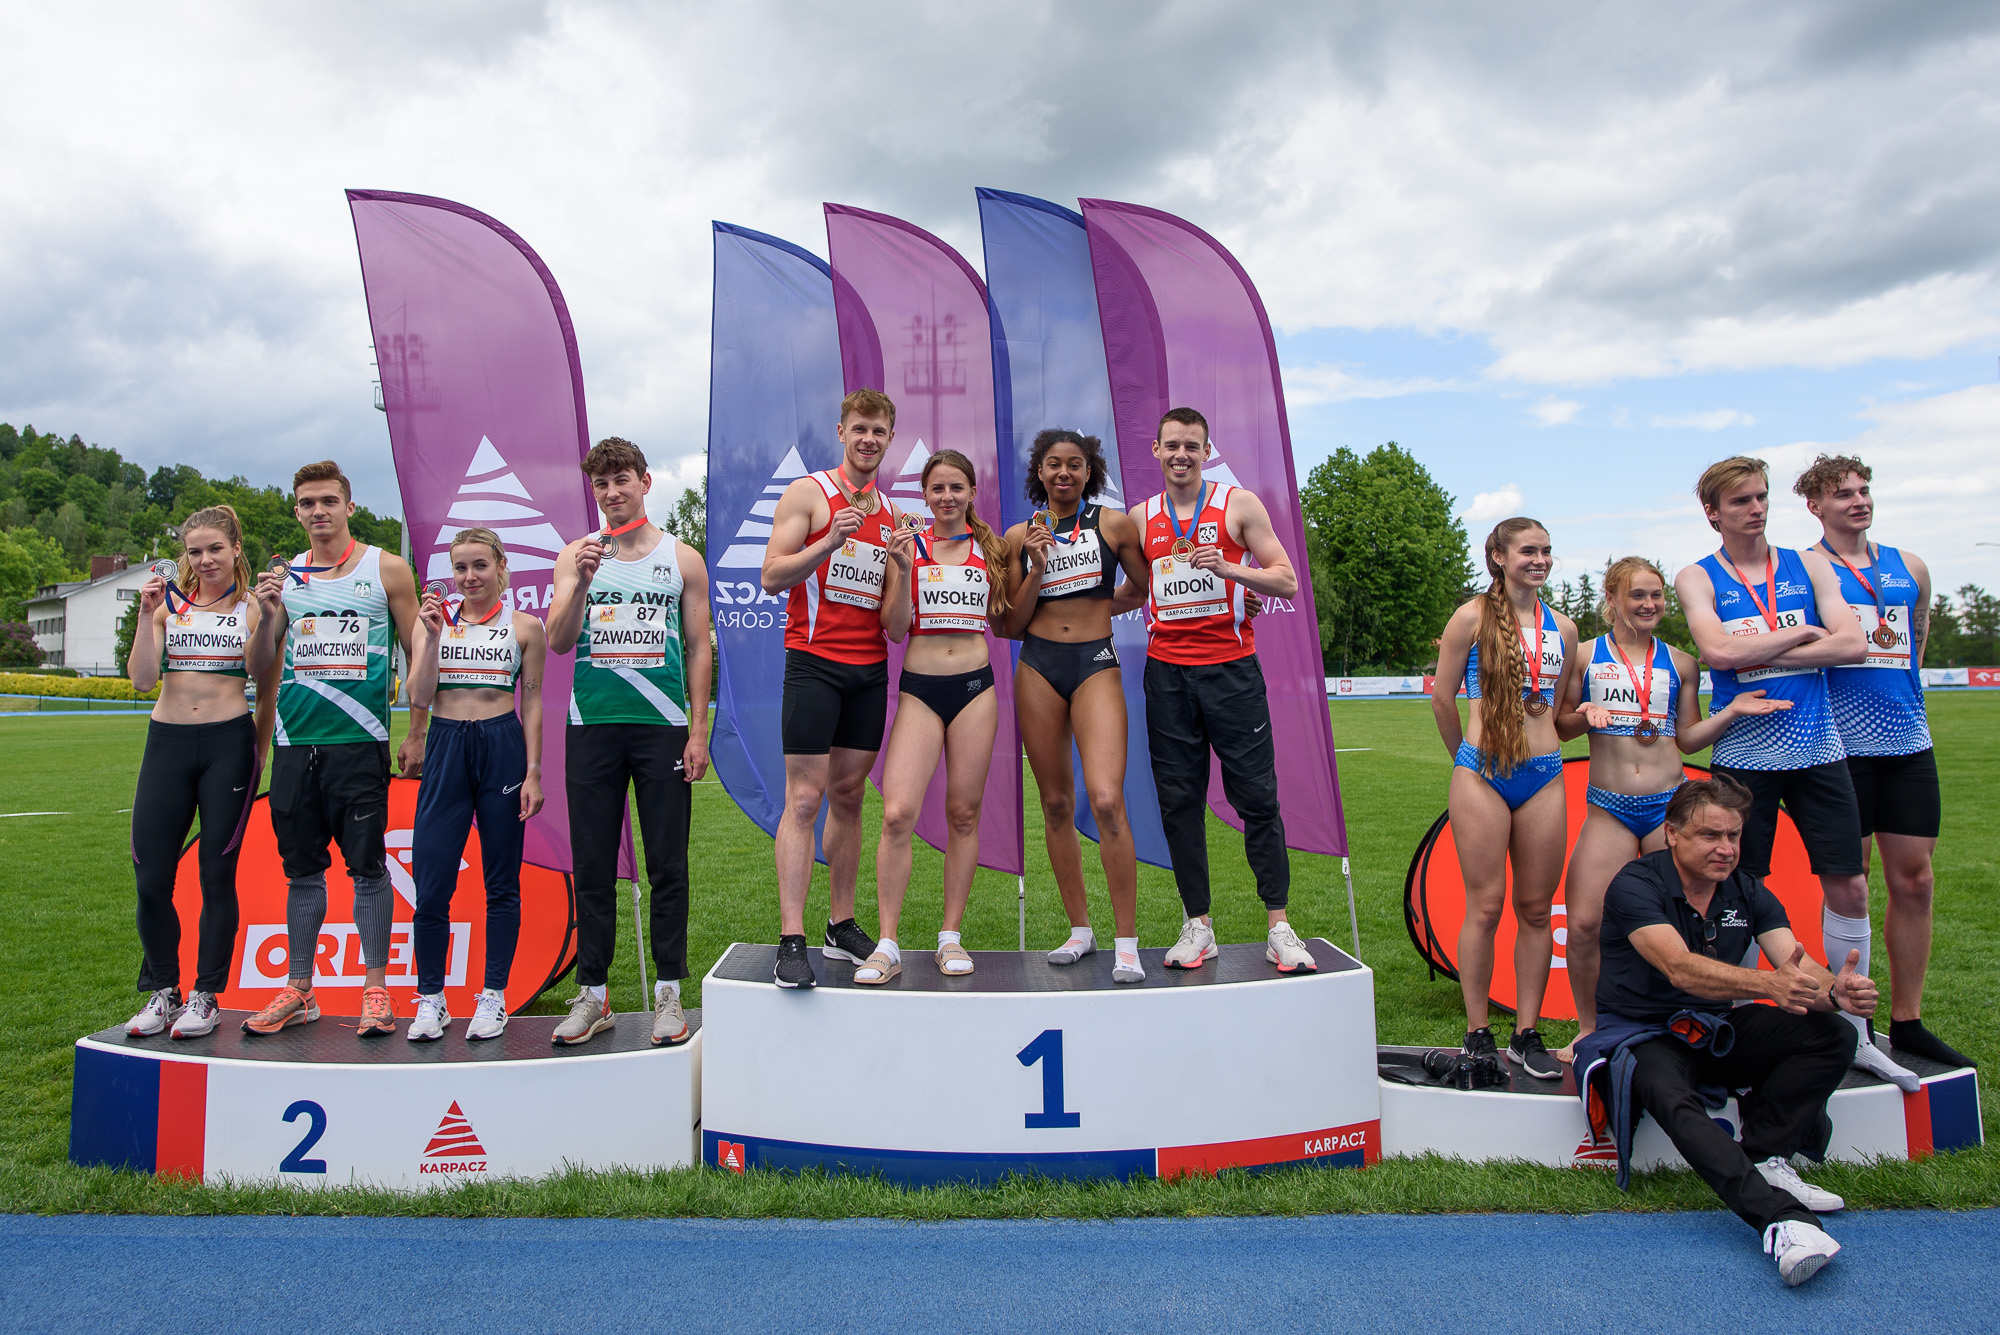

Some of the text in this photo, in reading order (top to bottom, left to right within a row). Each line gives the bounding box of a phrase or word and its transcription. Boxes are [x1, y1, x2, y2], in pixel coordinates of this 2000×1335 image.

[872, 548, 887, 565] 92
[964, 568, 983, 583] 93
[1043, 579, 1088, 595] KARPACZ 2022
[1164, 574, 1214, 597] KIDOŃ
[586, 591, 623, 606] AZS
[833, 592, 863, 603] KARPACZ
[923, 590, 986, 607] WSOŁEK
[636, 607, 657, 621] 87
[1165, 605, 1210, 616] KARPACZ 2022
[216, 615, 238, 627] 78
[338, 619, 360, 633] 76
[1776, 613, 1798, 629] 18
[168, 633, 243, 648] BARTNOWSKA
[488, 628, 508, 641] 79
[592, 630, 664, 645] ZAWADZKI
[296, 642, 365, 657] ADAMCZEWSKI
[441, 645, 513, 663] BIELIŃSKA
[1748, 667, 1784, 678] KARPACZ
[1610, 715, 1630, 723] PACZ
[255, 932, 456, 979] ORLE
[1015, 1028, 1081, 1129] 1
[279, 1099, 328, 1174] 2
[1304, 1130, 1366, 1155] KARPACZ
[419, 1161, 488, 1174] KARPACZ
